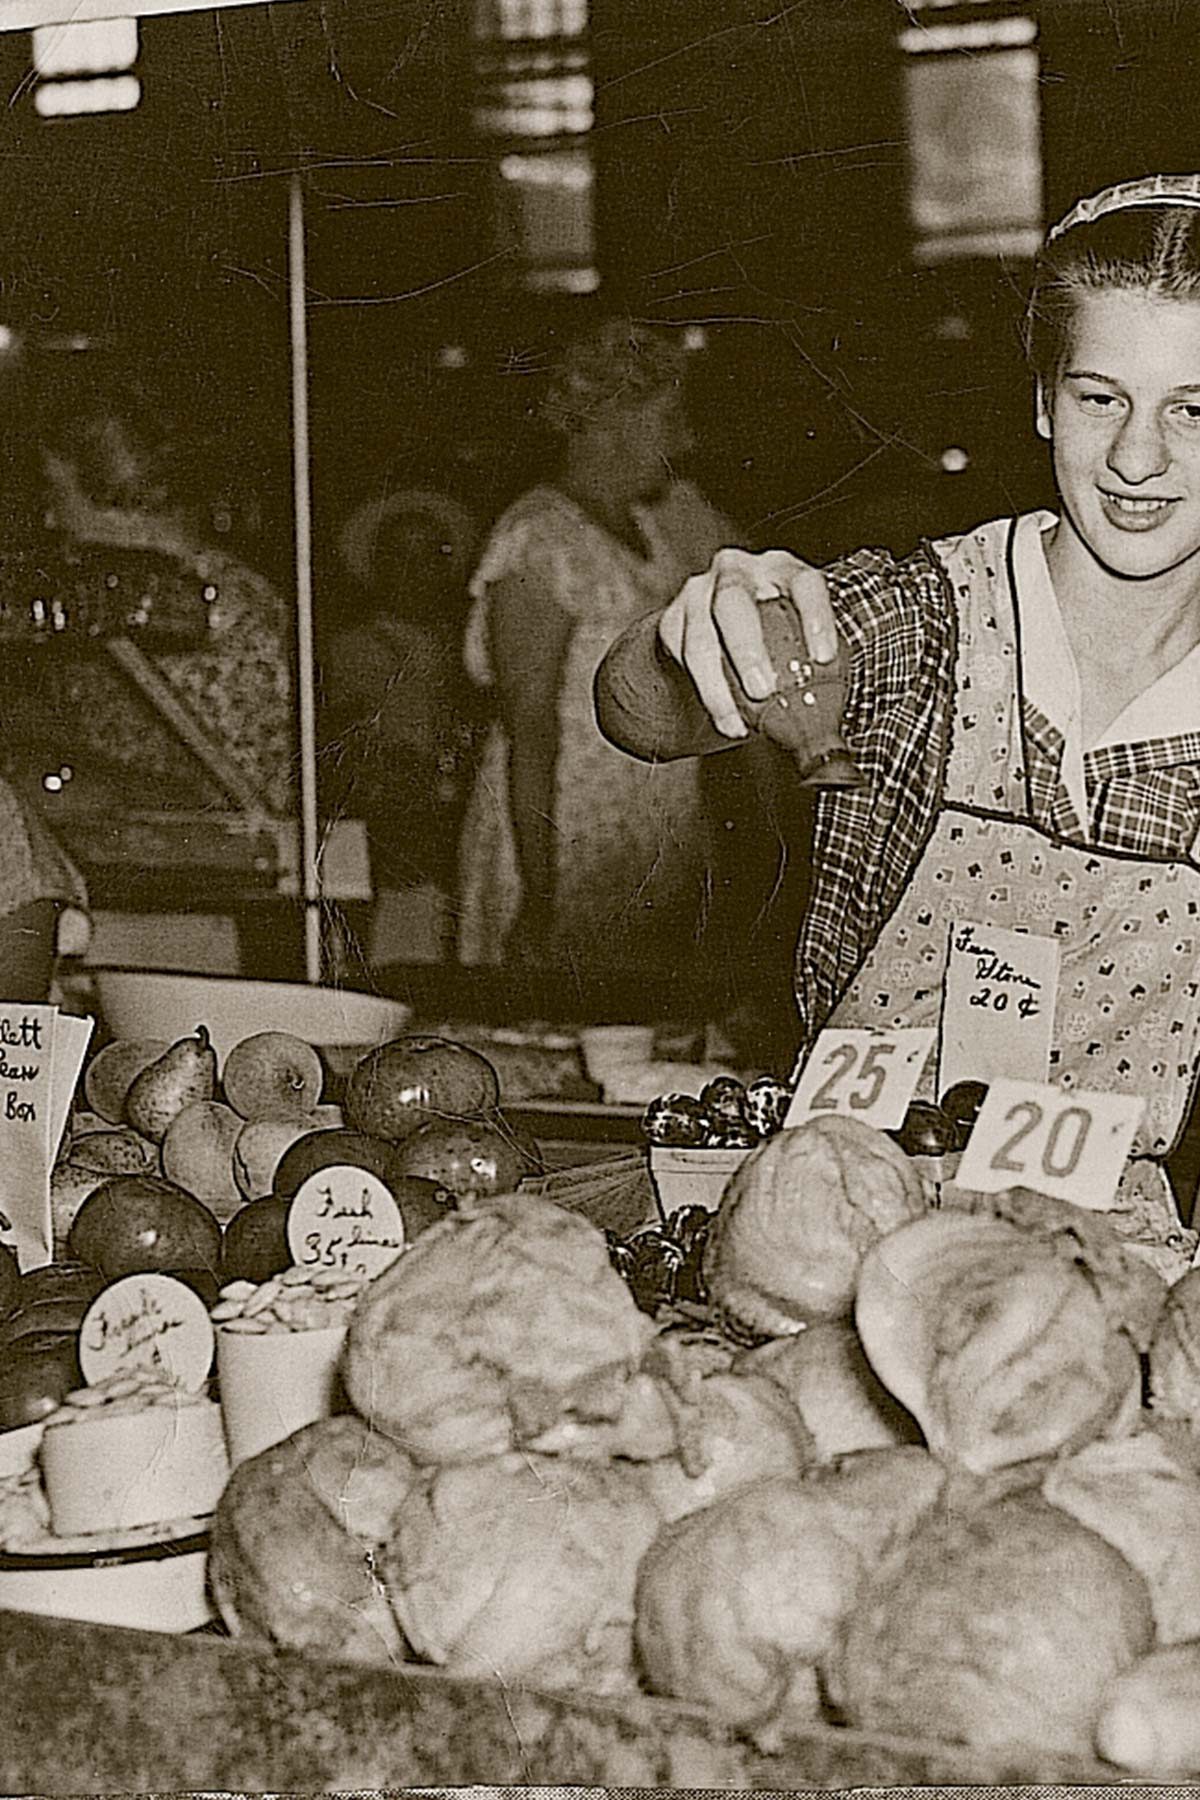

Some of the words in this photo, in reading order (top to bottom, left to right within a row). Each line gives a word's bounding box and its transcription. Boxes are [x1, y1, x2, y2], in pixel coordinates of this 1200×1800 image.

[975, 957, 1042, 989] Stone
[0, 1015, 43, 1050] lett
[809, 1043, 896, 1111] 25
[4, 1091, 36, 1122] Box
[990, 1101, 1093, 1178] 20
